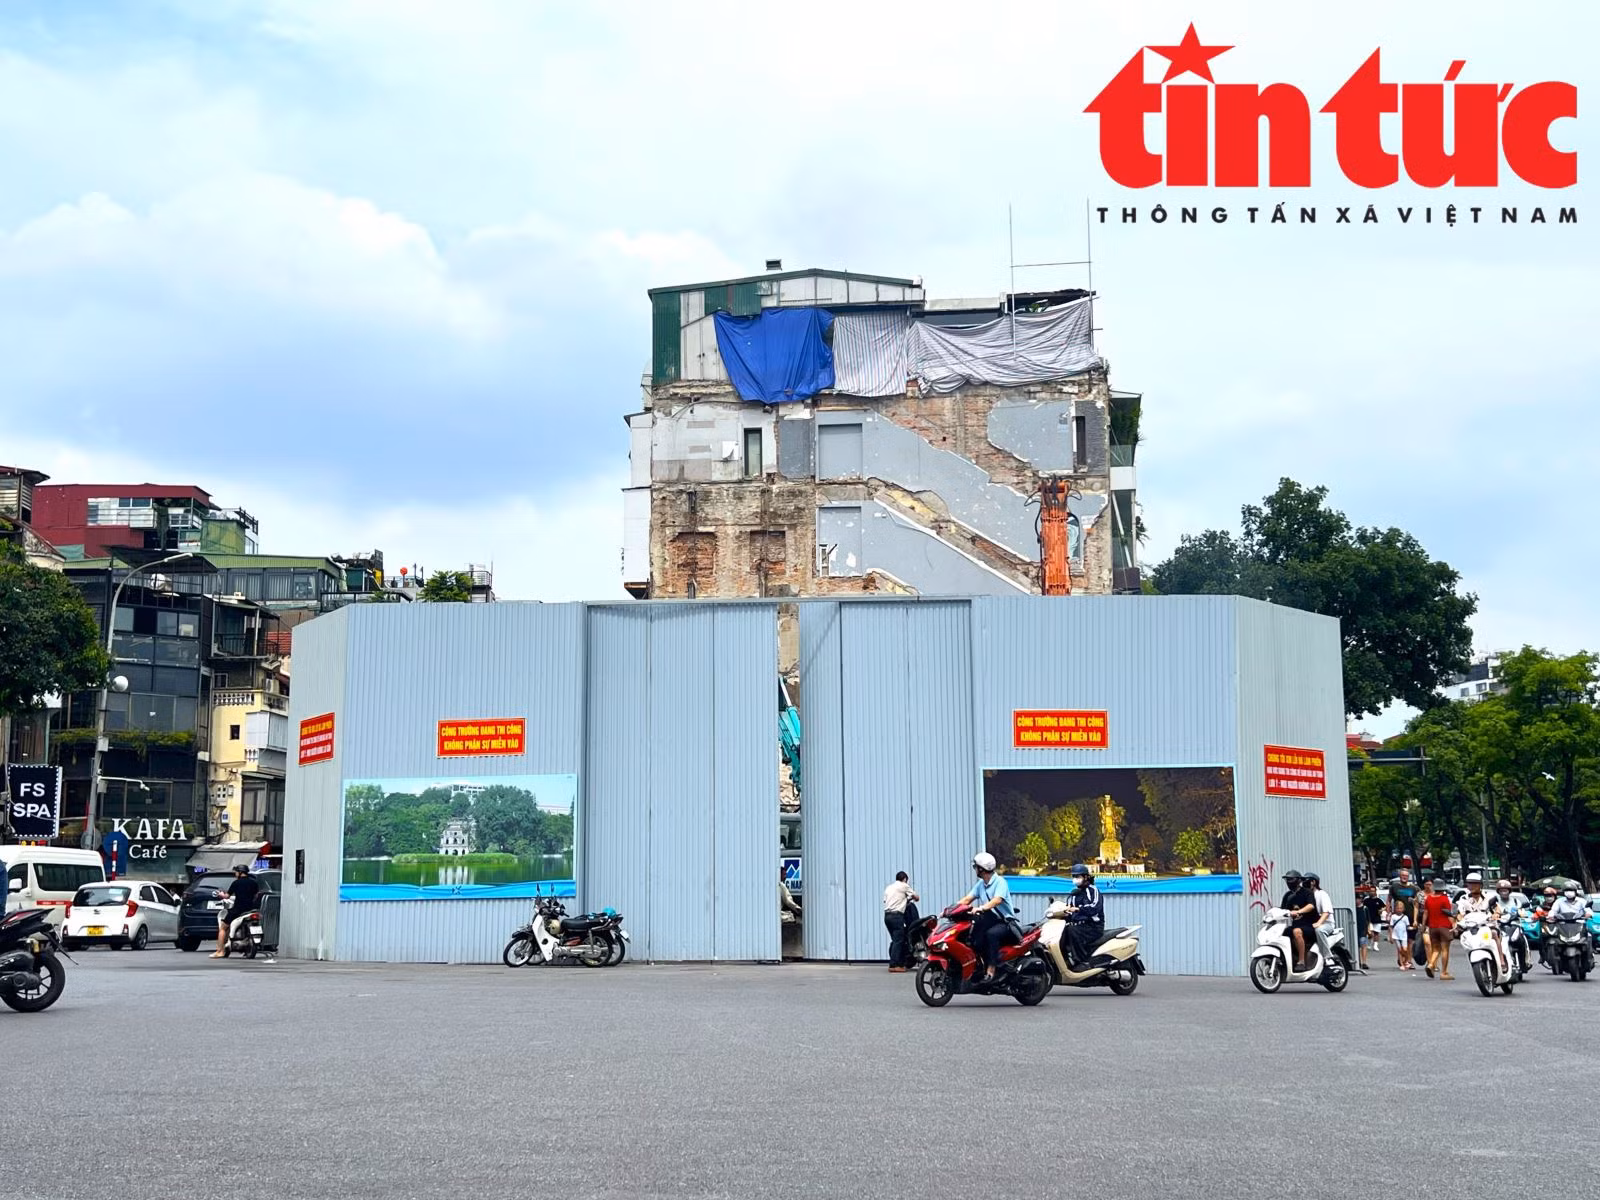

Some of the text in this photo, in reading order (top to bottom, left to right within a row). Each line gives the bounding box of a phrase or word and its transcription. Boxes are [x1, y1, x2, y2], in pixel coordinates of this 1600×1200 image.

[1017, 715, 1033, 727] CÔNG
[1087, 715, 1104, 727] CÔNG
[441, 725, 456, 737] CÔNG
[497, 725, 505, 735] THI
[506, 723, 522, 735] CÔNG
[1020, 729, 1041, 742] KHÔNG
[443, 739, 464, 751] KHÔNG
[20, 782, 46, 798] FS
[13, 802, 52, 818] SPA
[111, 818, 188, 841] KAFA
[128, 844, 168, 859] Café
